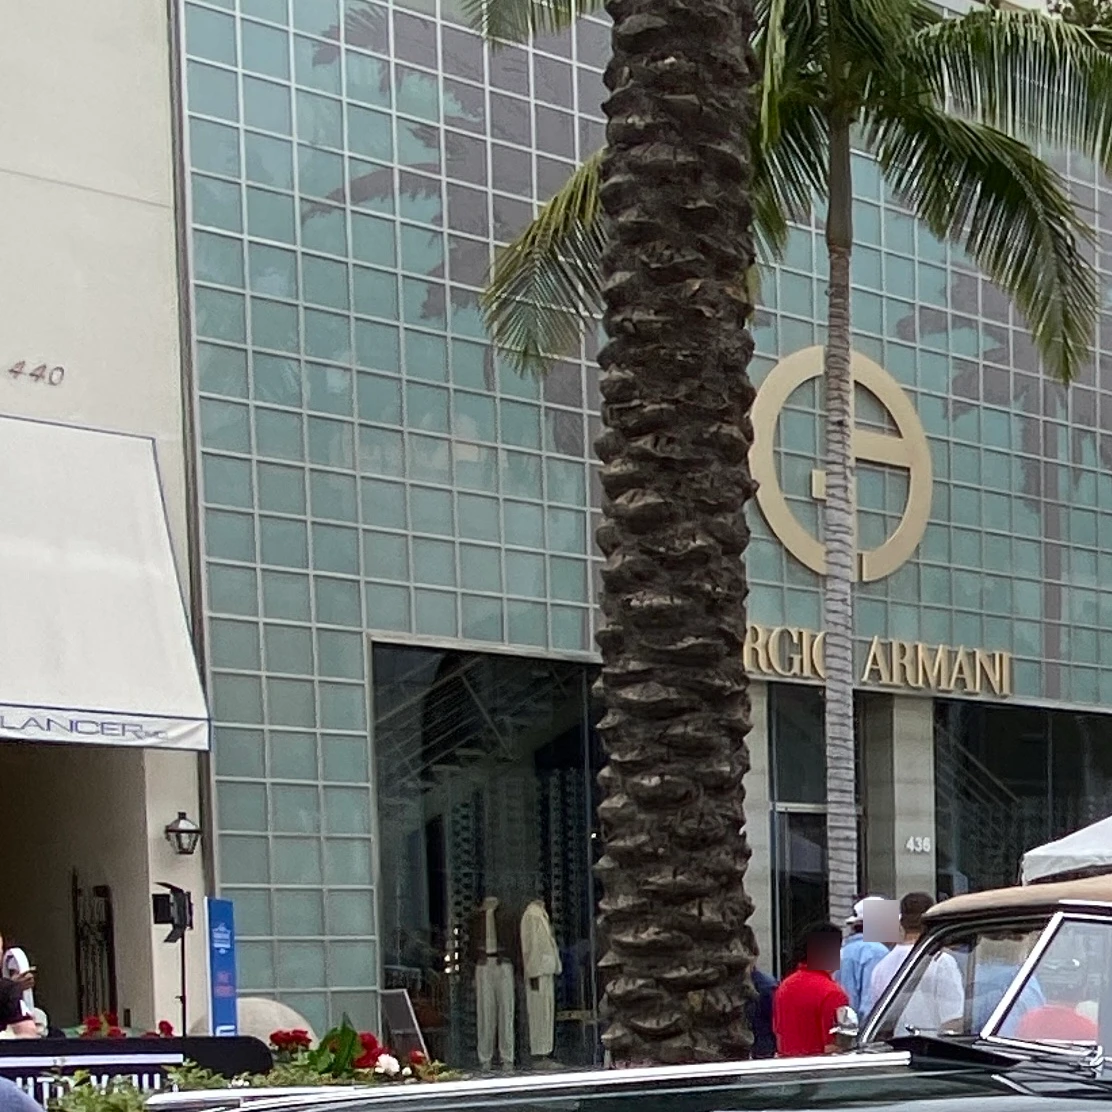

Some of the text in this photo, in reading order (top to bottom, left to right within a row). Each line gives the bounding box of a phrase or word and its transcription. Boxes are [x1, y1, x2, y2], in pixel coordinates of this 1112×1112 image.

[8, 360, 65, 386] 440
[861, 635, 1011, 697] ARMANI
[906, 836, 930, 852] 436
